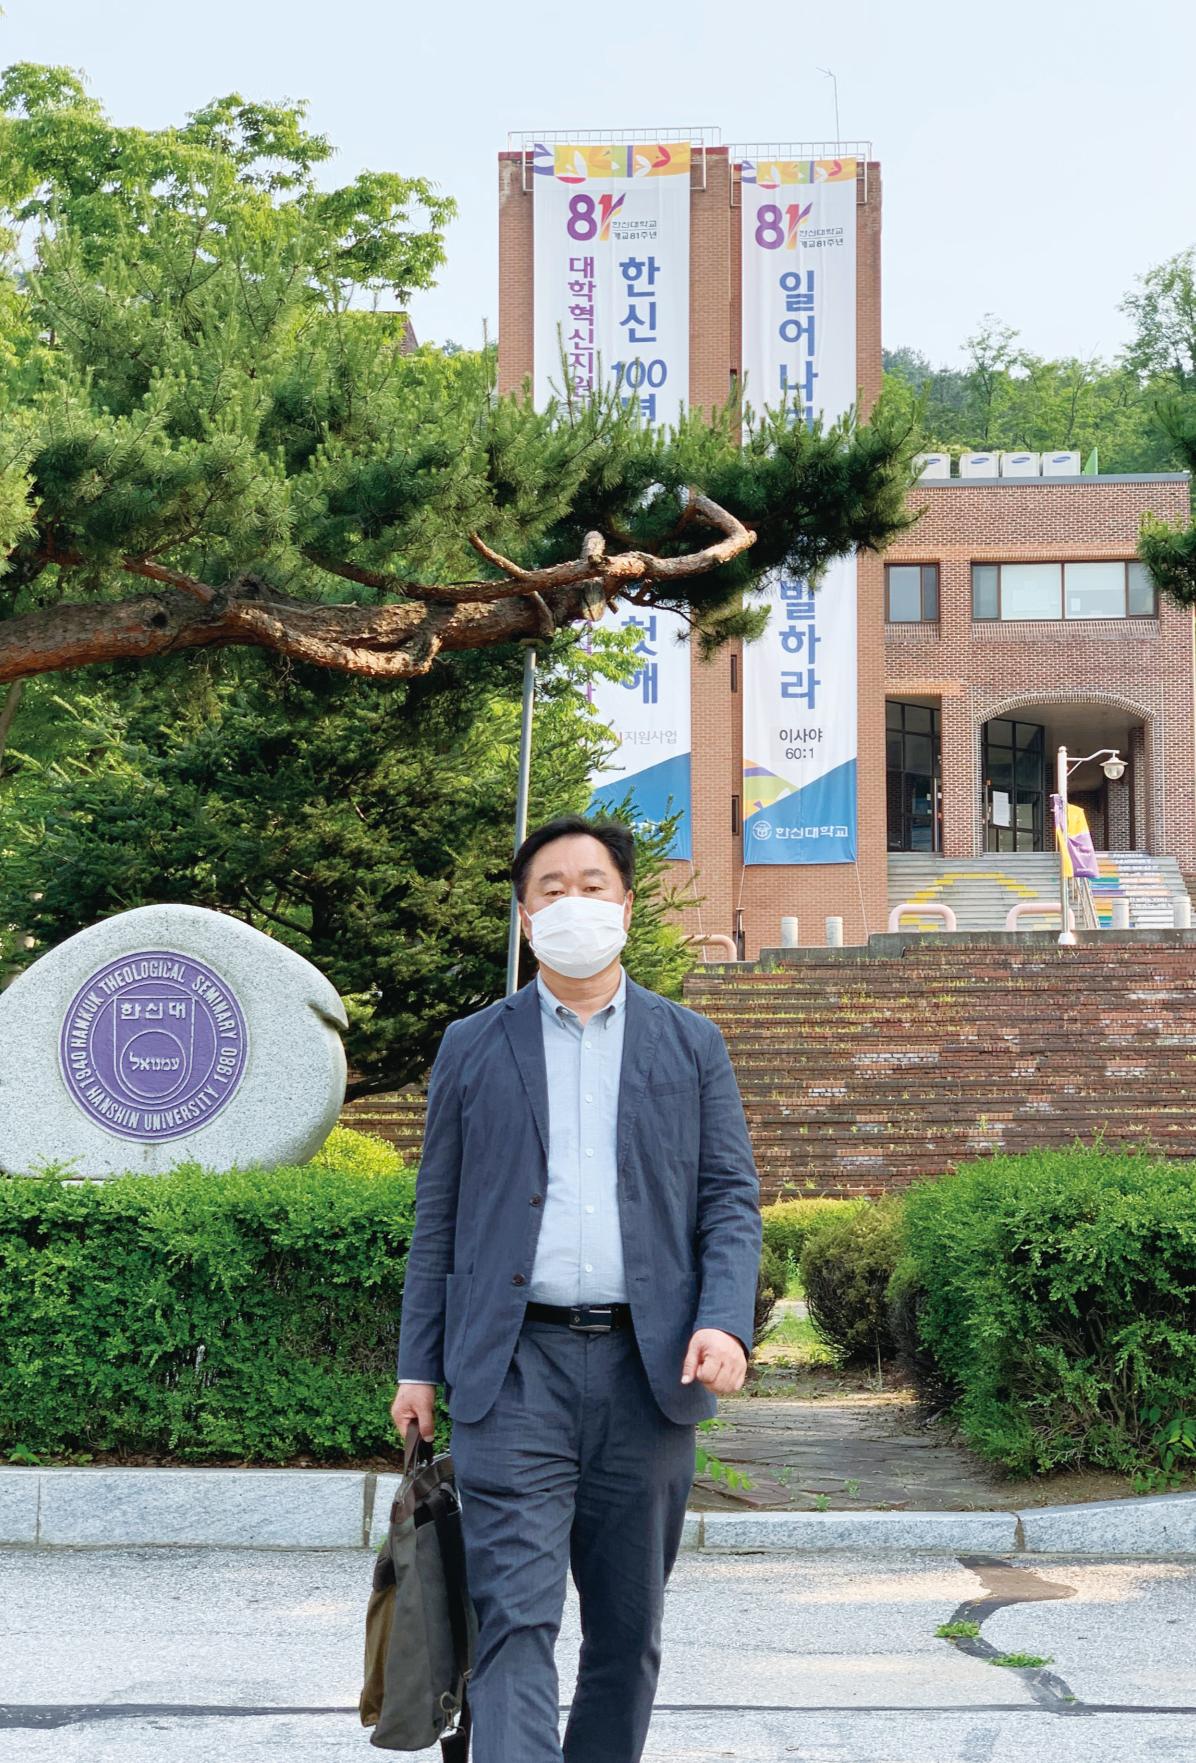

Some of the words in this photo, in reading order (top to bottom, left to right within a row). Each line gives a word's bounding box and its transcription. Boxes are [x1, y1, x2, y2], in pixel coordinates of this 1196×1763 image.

[567, 192, 626, 241] 81
[755, 202, 813, 250] 81
[619, 256, 661, 343] 한신
[567, 256, 596, 411] 대학혁신지원
[619, 730, 678, 745] 지원사업
[779, 728, 823, 744] 이사야
[785, 747, 815, 760] 60:1
[775, 825, 849, 839] 한신대학교
[70, 991, 105, 1048] HANKUK
[98, 960, 186, 995] THEOLOGICAL
[191, 975, 238, 1039] SEMINARY
[70, 1051, 95, 1088] 1940
[213, 1047, 238, 1083] 1980
[86, 1085, 140, 1129] HANSHIN
[144, 1085, 219, 1131] UNIVERSITY
